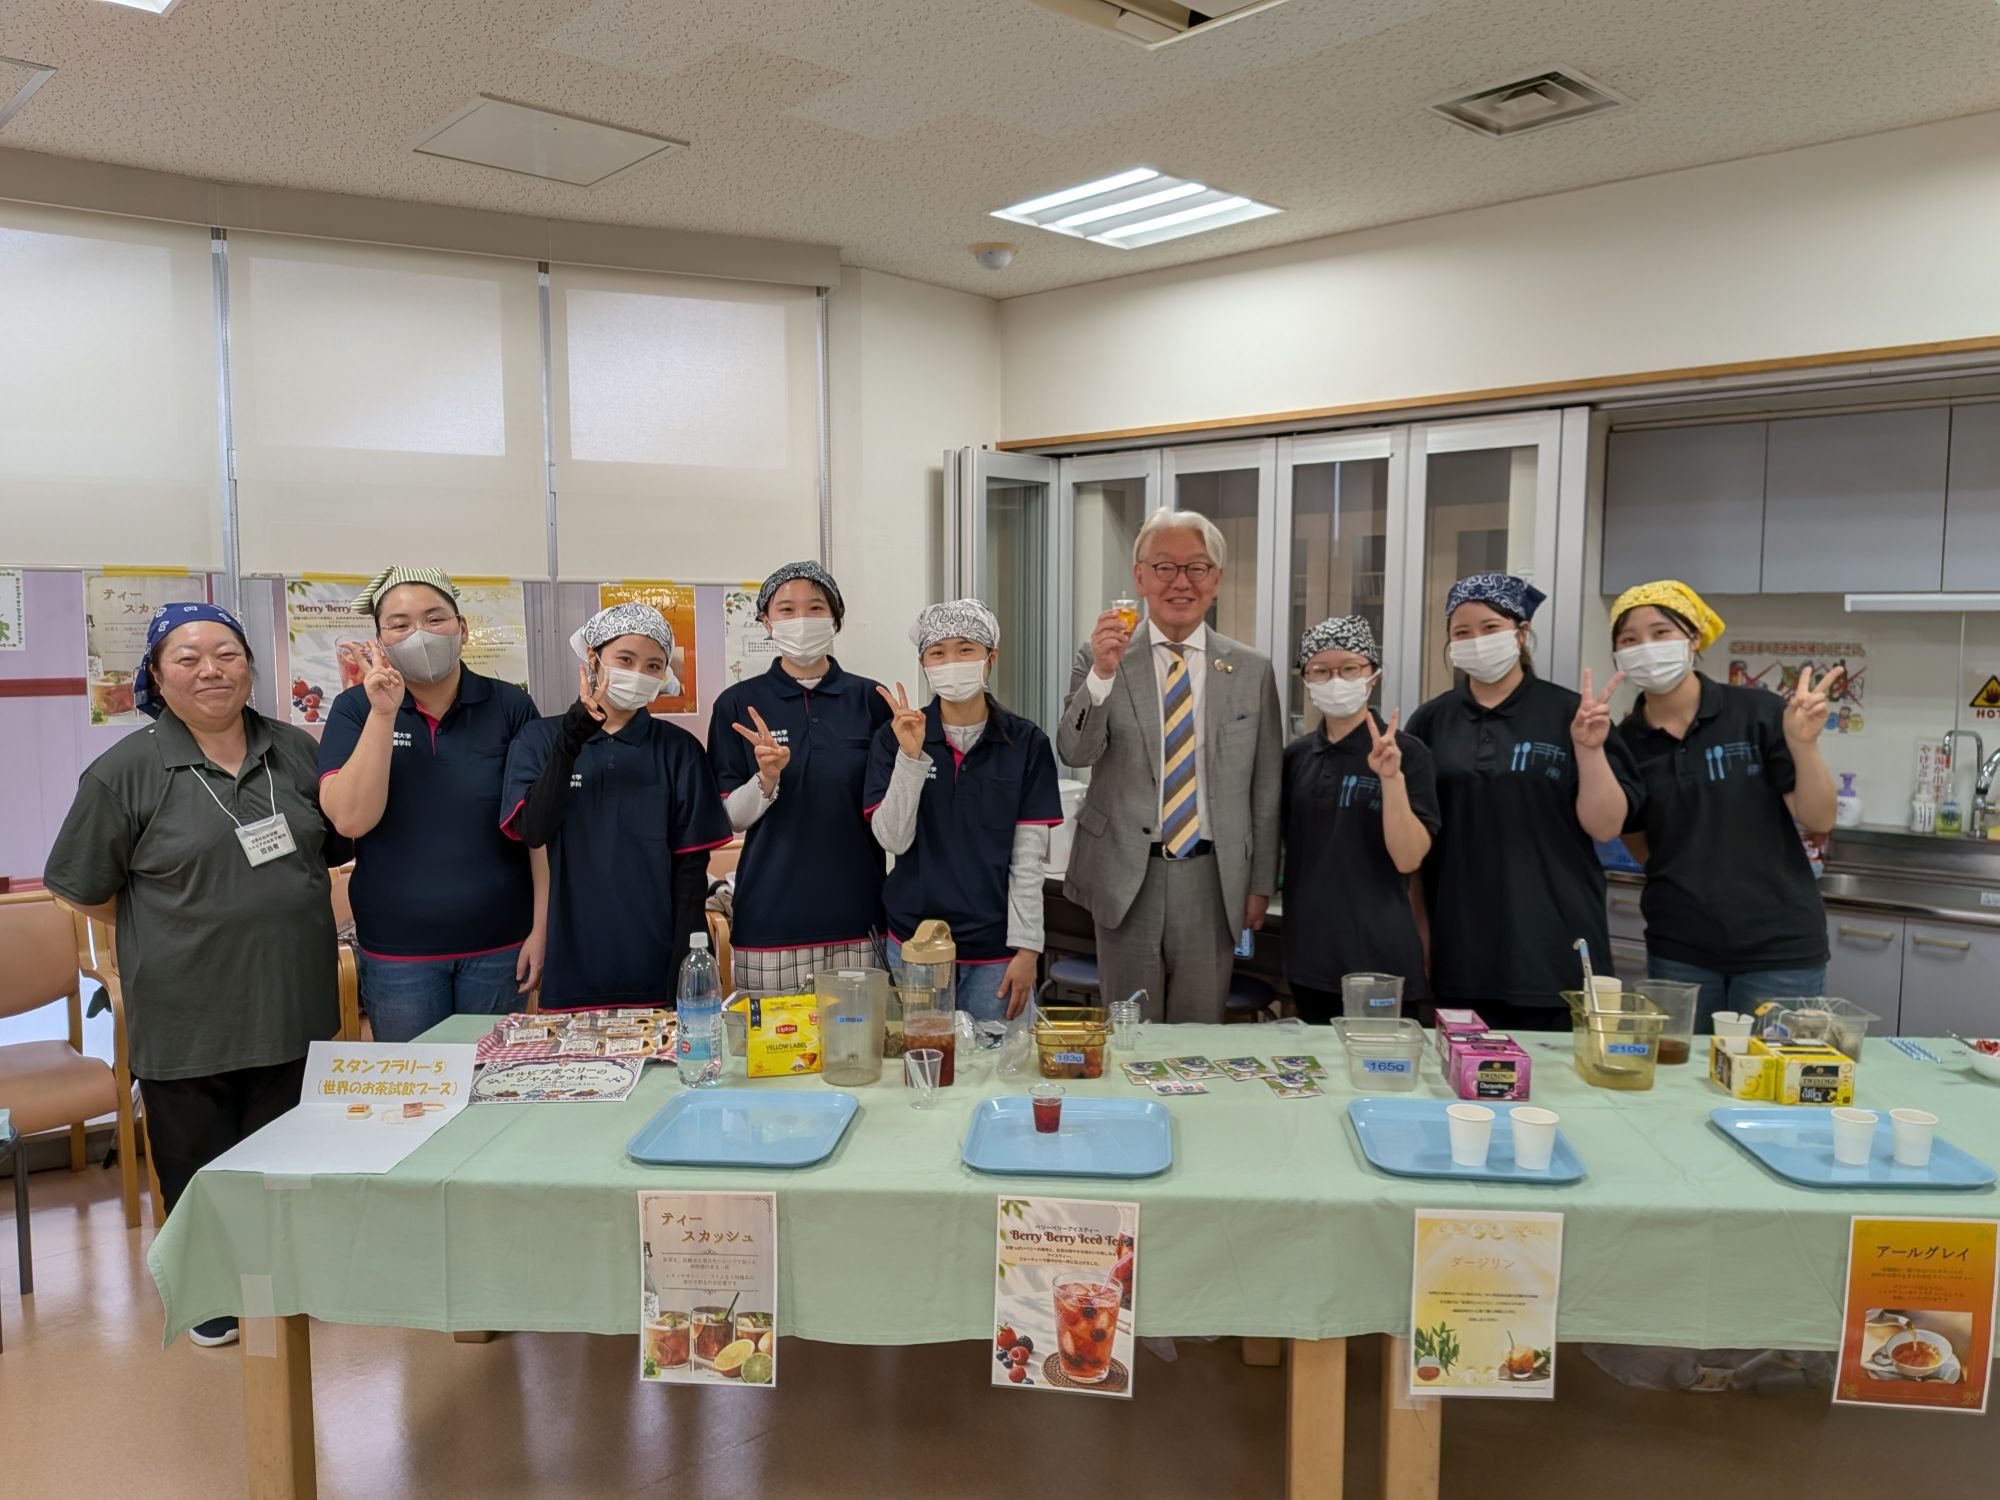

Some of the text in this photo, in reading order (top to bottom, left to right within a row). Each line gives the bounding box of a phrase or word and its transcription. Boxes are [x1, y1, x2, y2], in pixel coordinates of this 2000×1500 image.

[103, 588, 142, 600] ティー
[296, 604, 352, 614] Berry Berry
[765, 1042, 808, 1051] YELLOW LABEL
[1370, 1062, 1405, 1072] 165g
[661, 1212, 703, 1226] ティー
[681, 1230, 754, 1243] スカッシュ
[1009, 1229, 1042, 1244] Berry
[1043, 1231, 1076, 1246] Berry
[1078, 1233, 1103, 1245] Iced
[1876, 1245, 1969, 1261] アールグレイ
[1451, 1256, 1515, 1270] ダージリン
